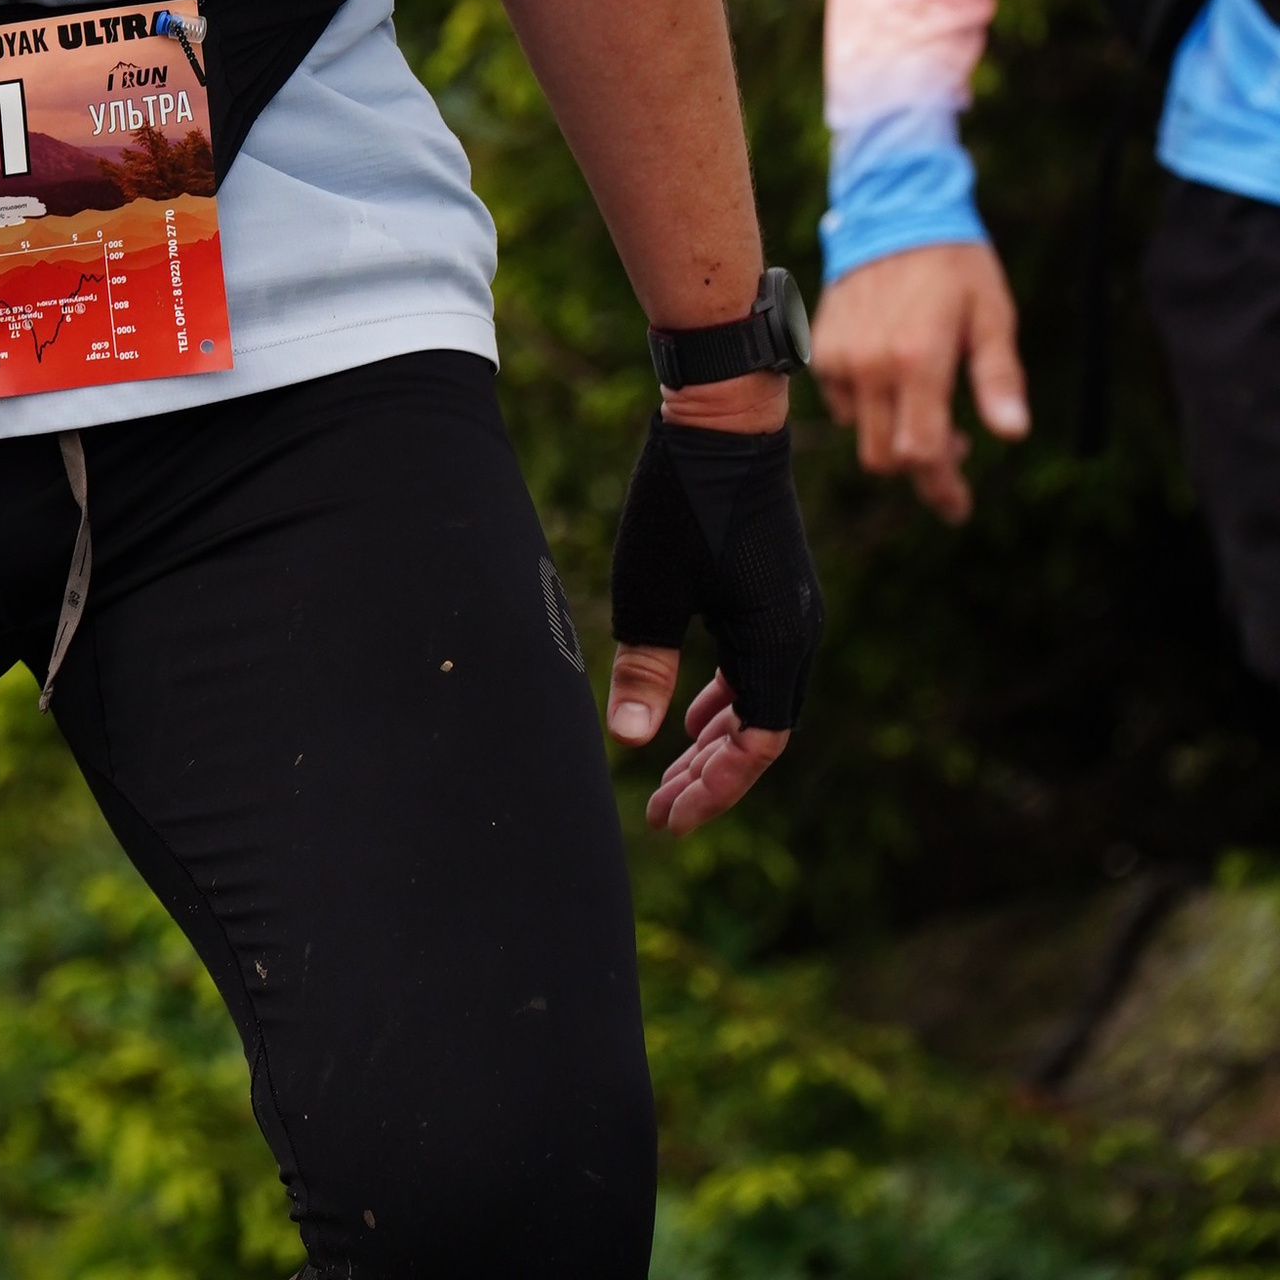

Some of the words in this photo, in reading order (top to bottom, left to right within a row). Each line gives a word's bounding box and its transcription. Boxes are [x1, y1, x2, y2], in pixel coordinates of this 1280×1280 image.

[122, 65, 168, 89] RUN
[88, 90, 195, 137] УЛЬТРА
[165, 209, 175, 223] 70
[96, 230, 103, 238] 0
[166, 224, 177, 238] 27
[72, 233, 78, 241] 5
[20, 241, 30, 249] 15
[108, 240, 123, 248] 300
[167, 239, 178, 259] 700
[109, 251, 124, 260] 400
[170, 260, 183, 287] (922)
[111, 276, 127, 284] 600
[173, 288, 183, 296] 8
[36, 299, 57, 308] ключ
[59, 293, 98, 306] Гремучий
[114, 300, 130, 309] 800
[12, 305, 24, 314] КВ
[61, 305, 74, 314] ПП
[18, 311, 43, 321] Приют
[65, 314, 72, 323] 9
[8, 321, 20, 331] ПП
[116, 325, 136, 334] 1000
[10, 330, 20, 339] 17
[177, 328, 188, 353] ТЕЛ.
[91, 341, 110, 351] 6:00
[85, 351, 110, 361] старт
[119, 350, 139, 360] 1200
